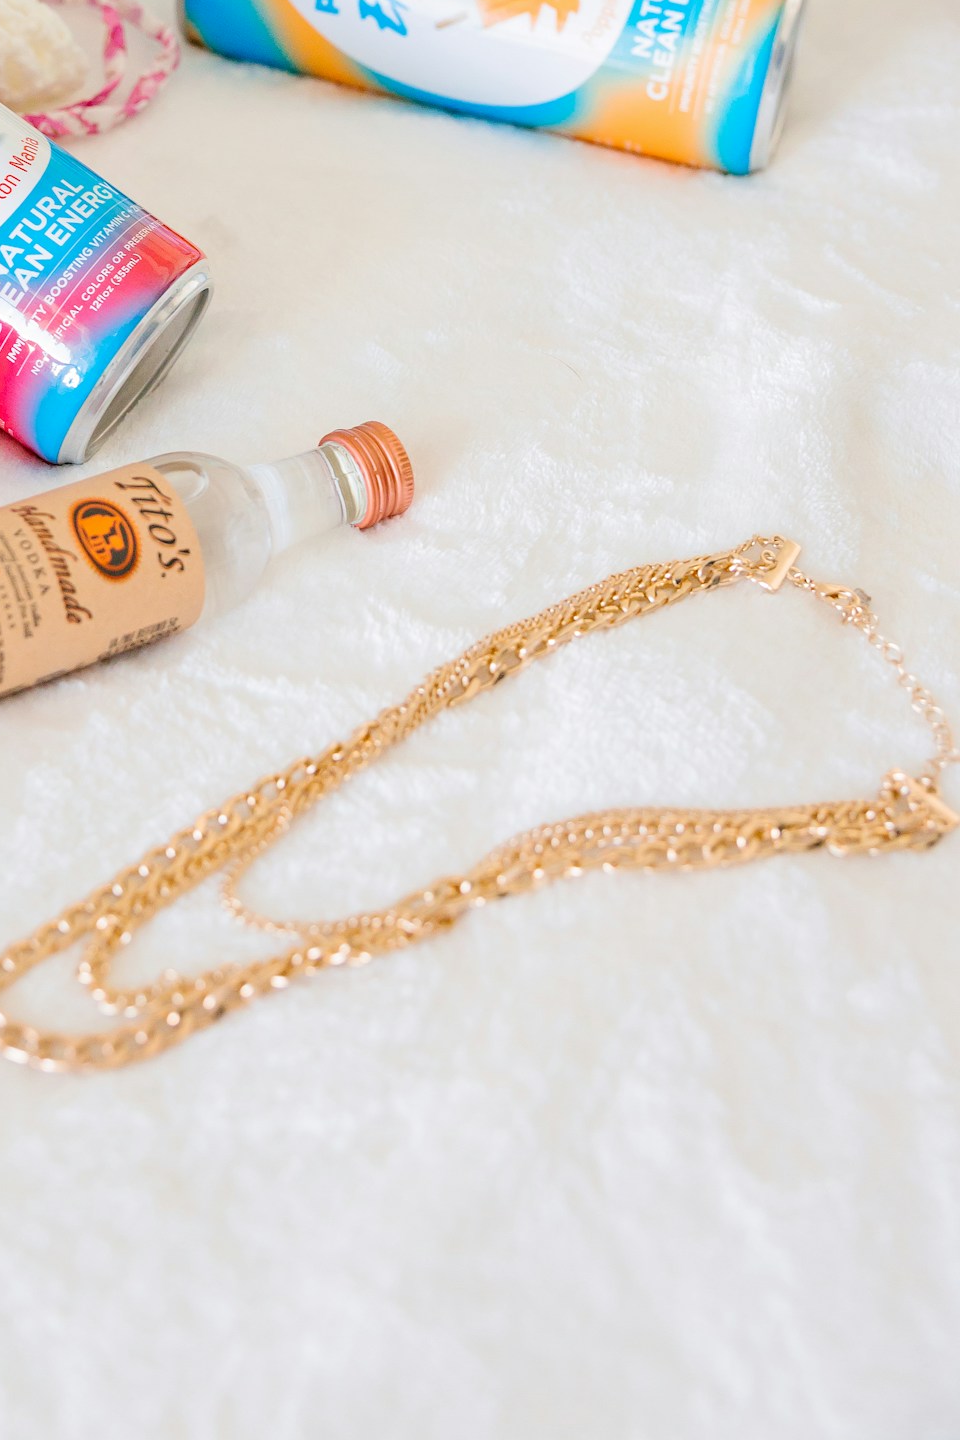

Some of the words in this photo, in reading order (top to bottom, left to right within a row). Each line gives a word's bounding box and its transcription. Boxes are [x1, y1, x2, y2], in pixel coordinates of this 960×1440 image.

[646, 9, 685, 101] CLEAN
[8, 136, 40, 173] Mania
[44, 181, 120, 247] ENERGY
[6, 303, 47, 363] IMMTY
[43, 246, 94, 306] BOOSTING
[88, 215, 126, 248] VITAMIN
[30, 360, 44, 376] NO
[41, 304, 84, 362] AIFICIAL
[81, 263, 115, 302] COLORS
[112, 250, 127, 265] OR
[123, 220, 162, 252] PRESERVAT
[89, 284, 115, 312] 12floz
[112, 253, 143, 287] (355mL)
[10, 505, 93, 624] Handmade
[13, 527, 50, 596] VODKA
